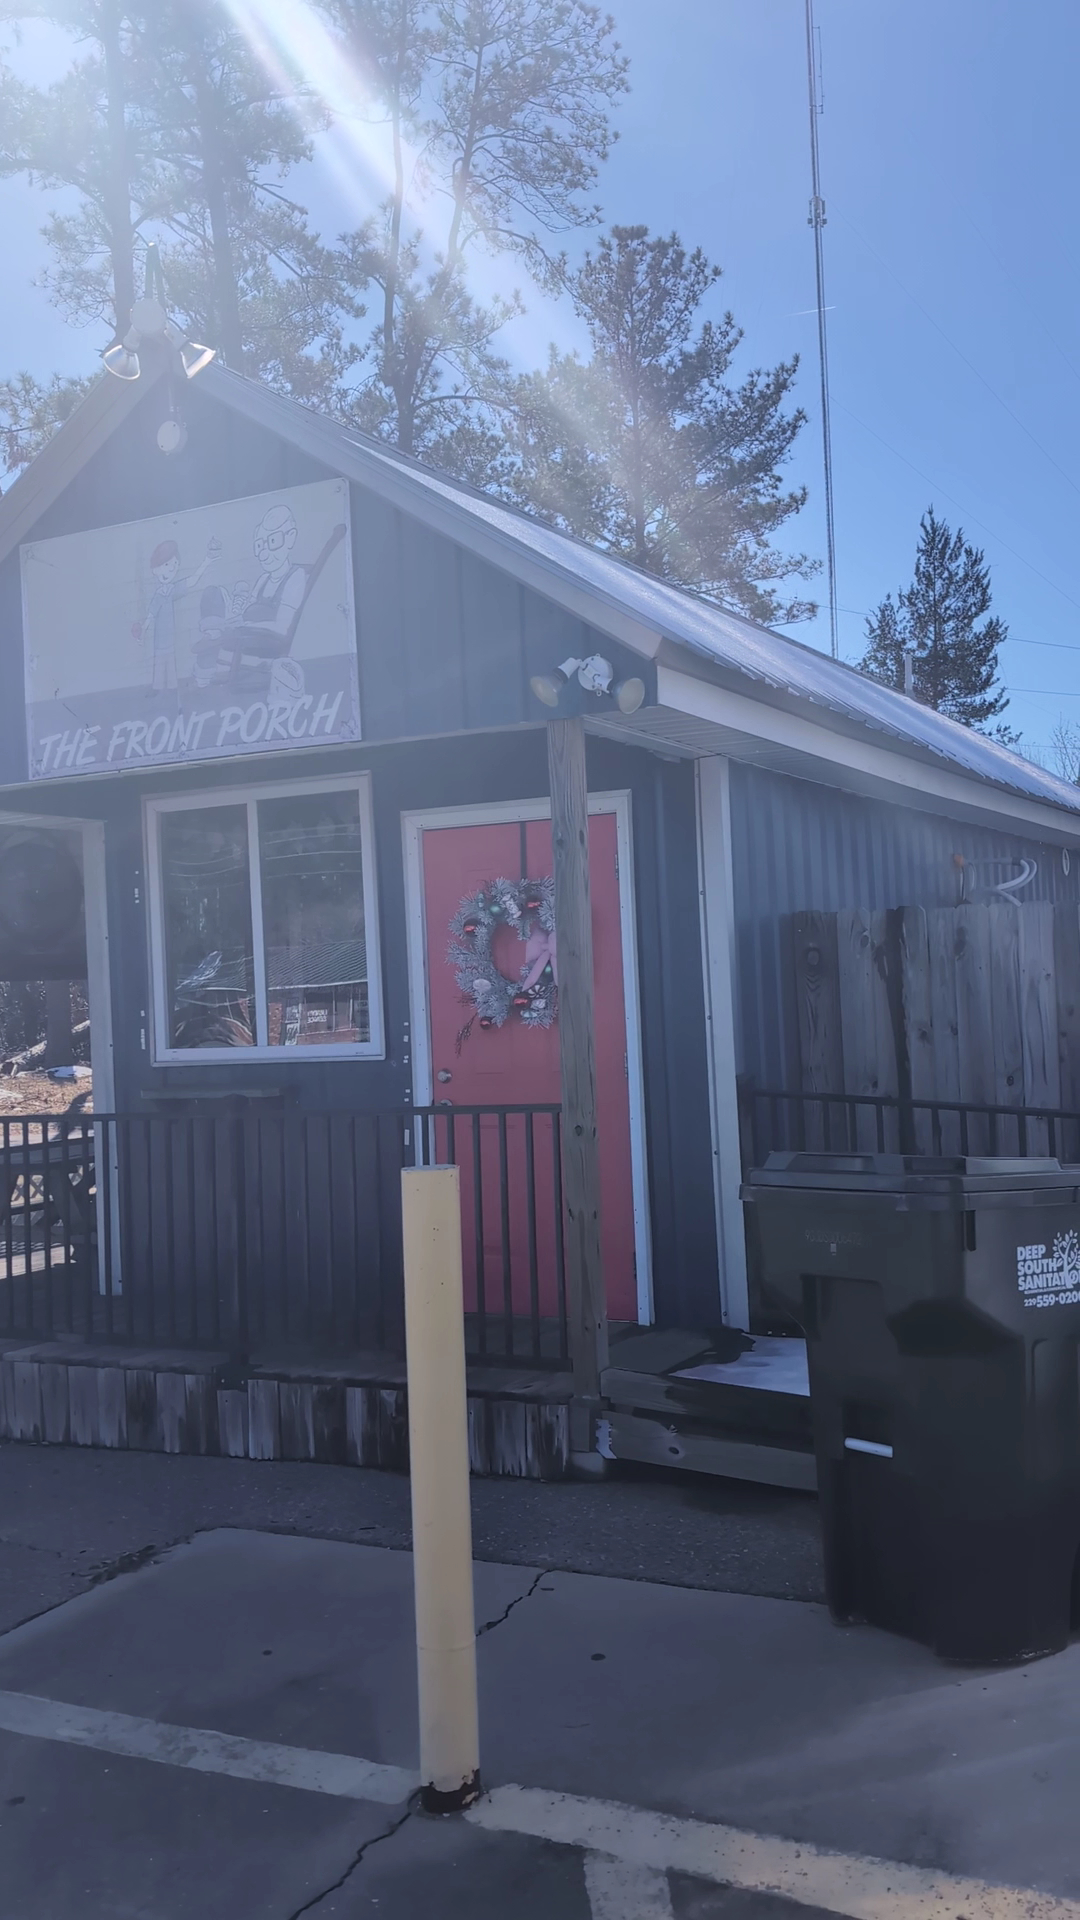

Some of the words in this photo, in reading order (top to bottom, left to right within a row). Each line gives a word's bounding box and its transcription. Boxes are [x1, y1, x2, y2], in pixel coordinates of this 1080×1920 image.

[39, 725, 102, 771] THE
[106, 710, 215, 762] FRONT
[219, 691, 345, 747] PORCH
[1017, 1244, 1046, 1261] DEEP
[1017, 1258, 1058, 1276] SOUTH
[1018, 1270, 1080, 1291] SANITATIO
